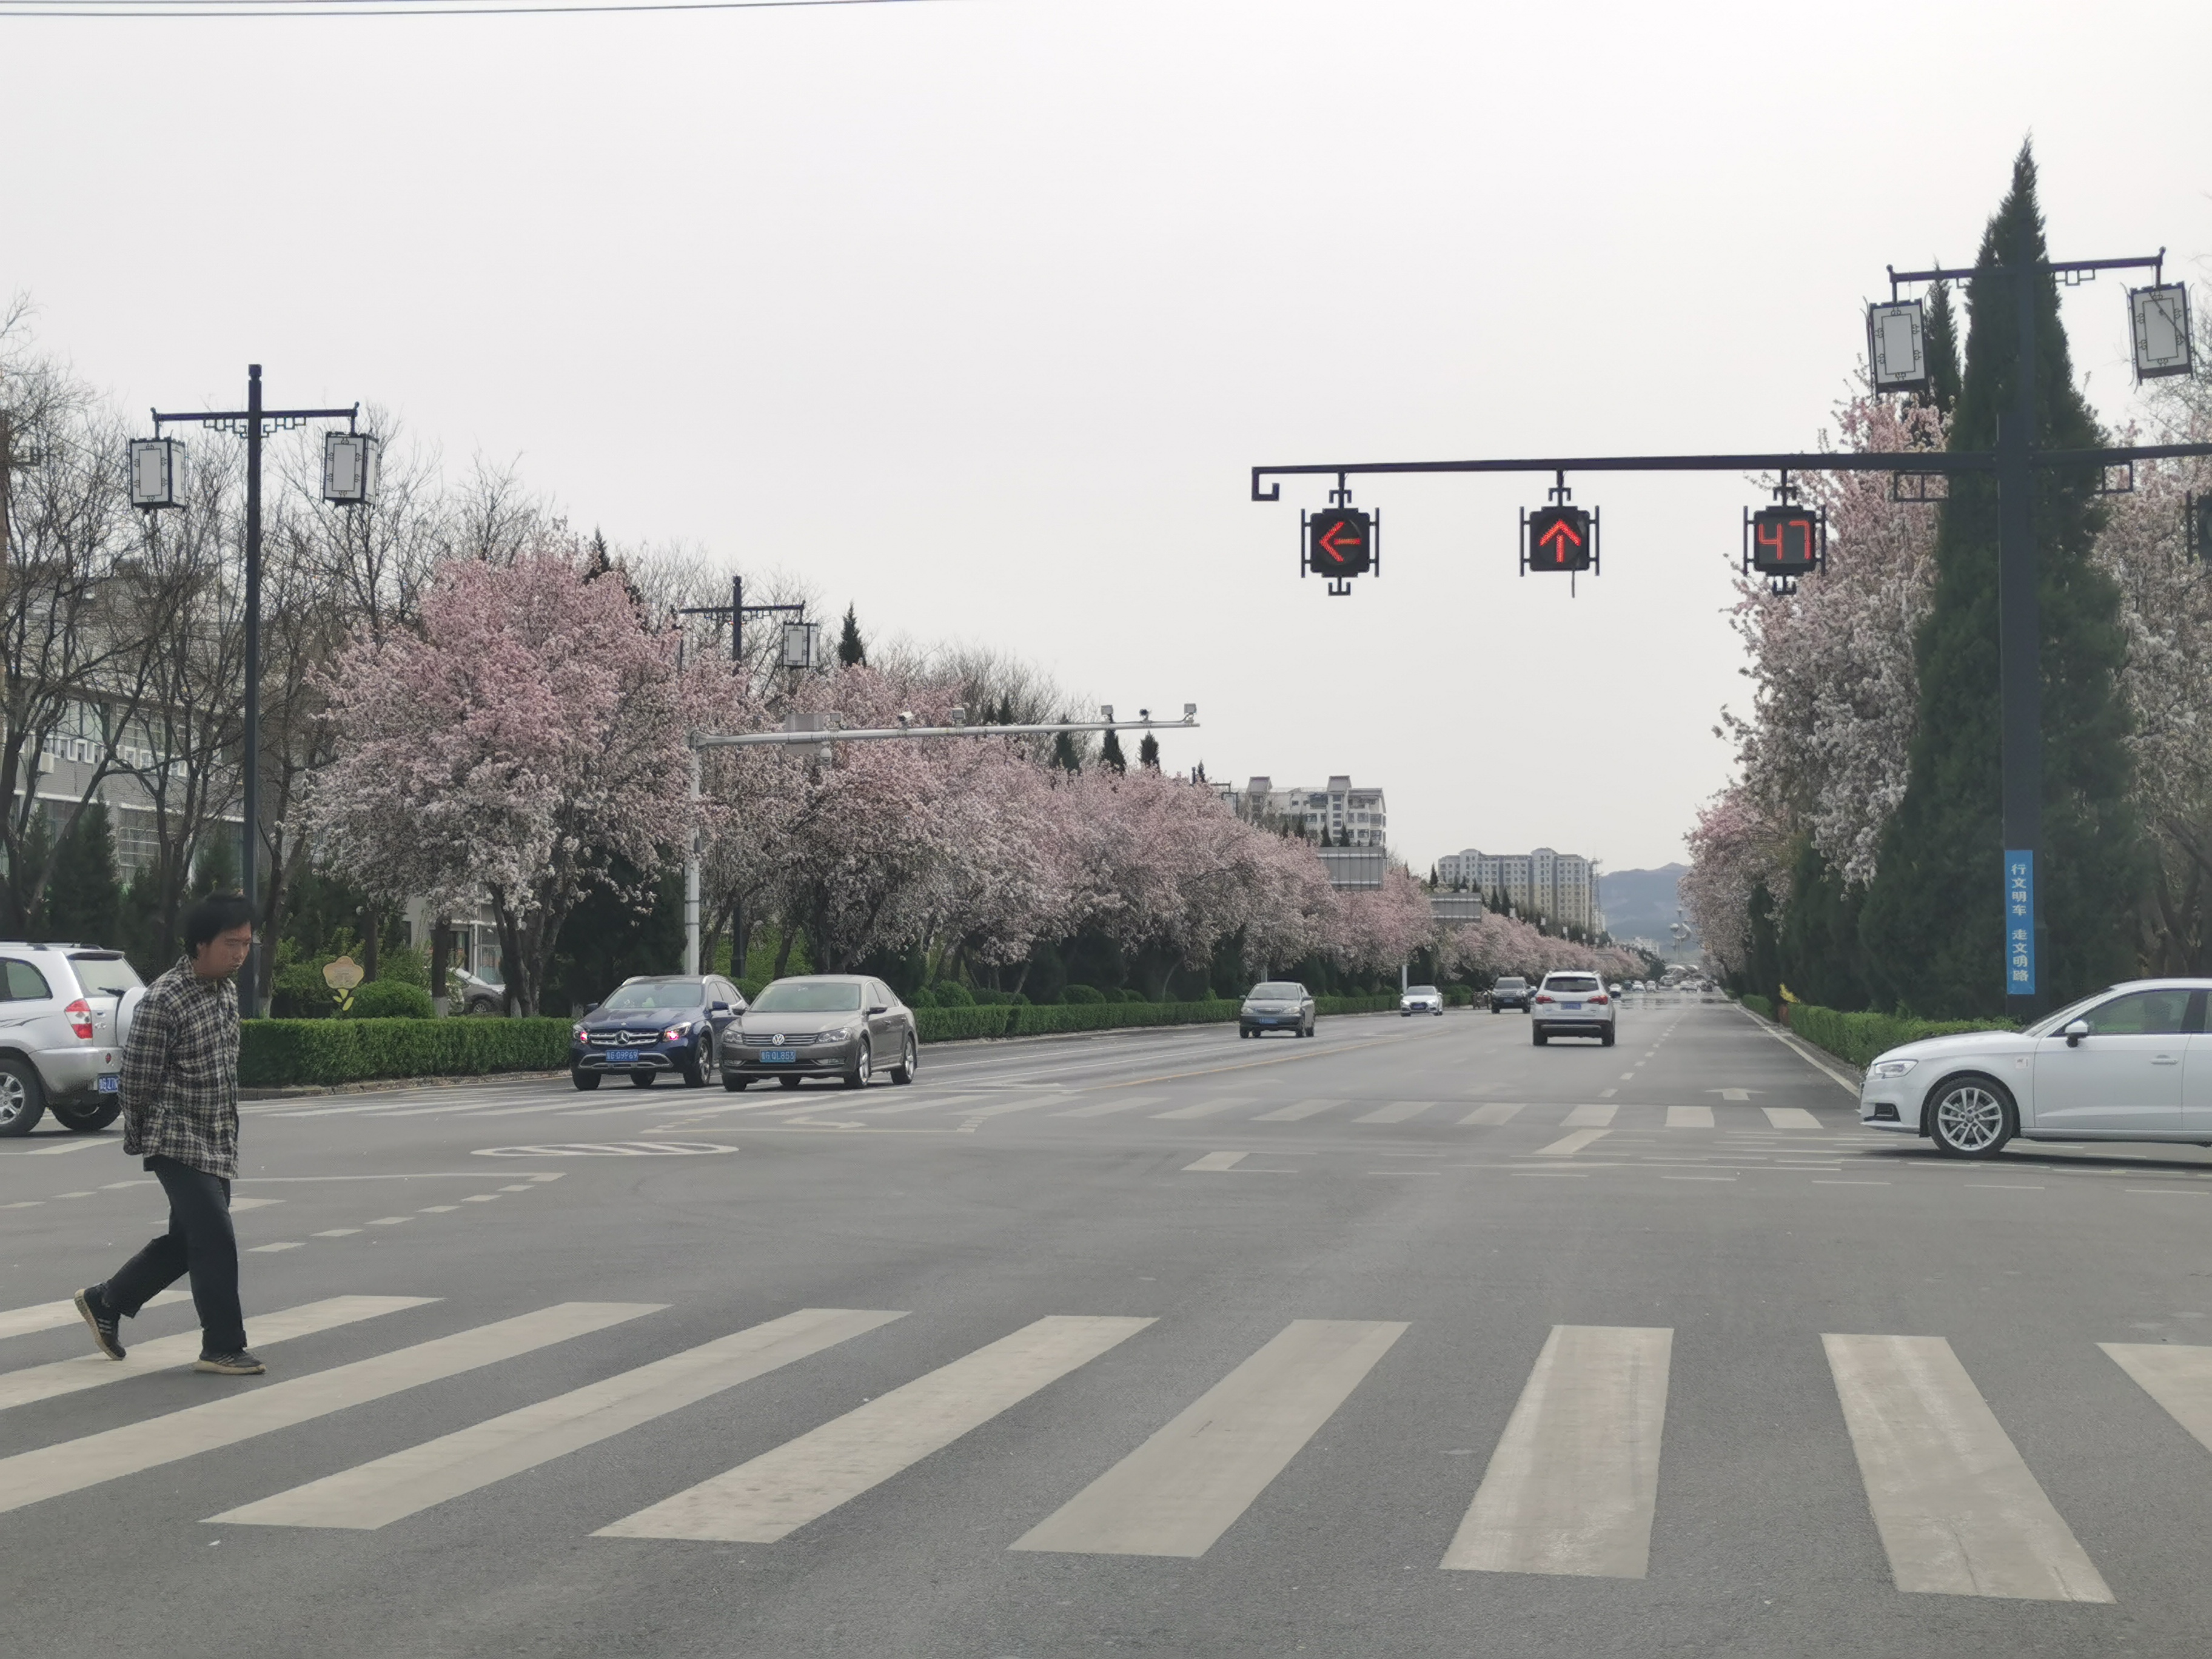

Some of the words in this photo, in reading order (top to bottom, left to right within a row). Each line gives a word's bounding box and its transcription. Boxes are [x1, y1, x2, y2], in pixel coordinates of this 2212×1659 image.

[1758, 520, 1811, 560] 47
[2011, 863, 2027, 916] 行文明车
[2012, 929, 2029, 982] 走文明路
